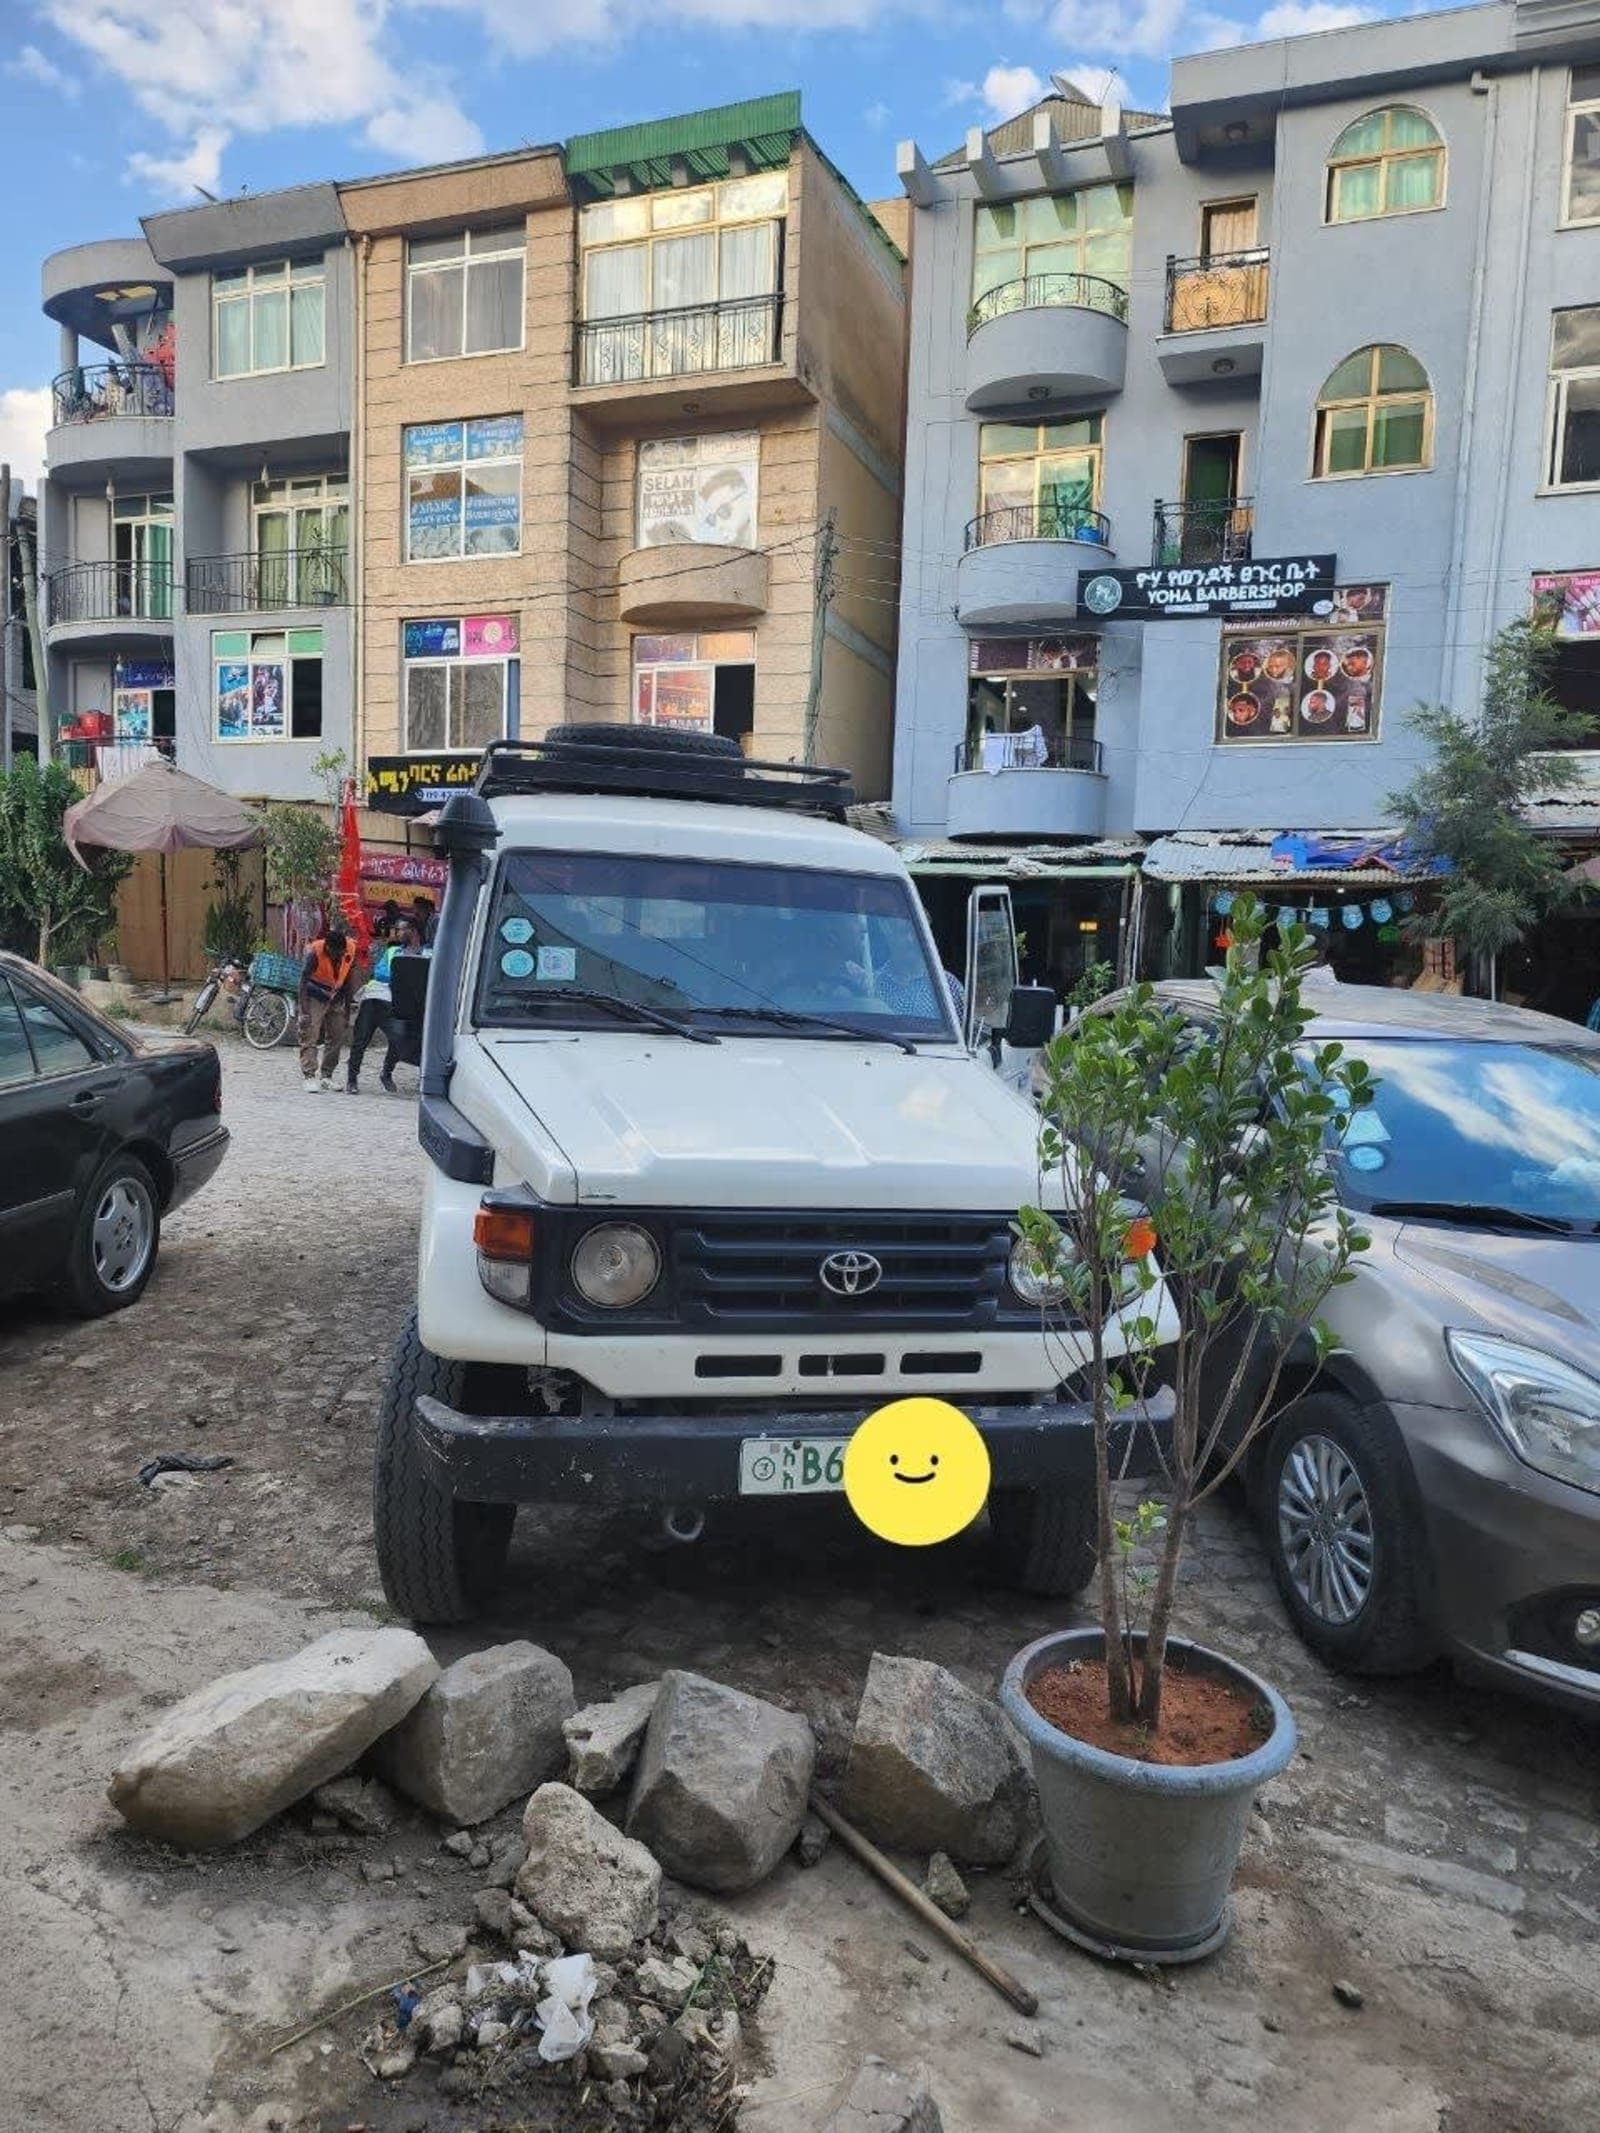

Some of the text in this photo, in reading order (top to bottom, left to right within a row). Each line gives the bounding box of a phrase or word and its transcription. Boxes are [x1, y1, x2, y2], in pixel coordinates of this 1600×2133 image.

[644, 472, 694, 491] SELAM
[1286, 560, 1321, 580] ቤት
[1147, 582, 1306, 604] YOHA BARBERSHOP
[802, 1446, 844, 1485] B6
